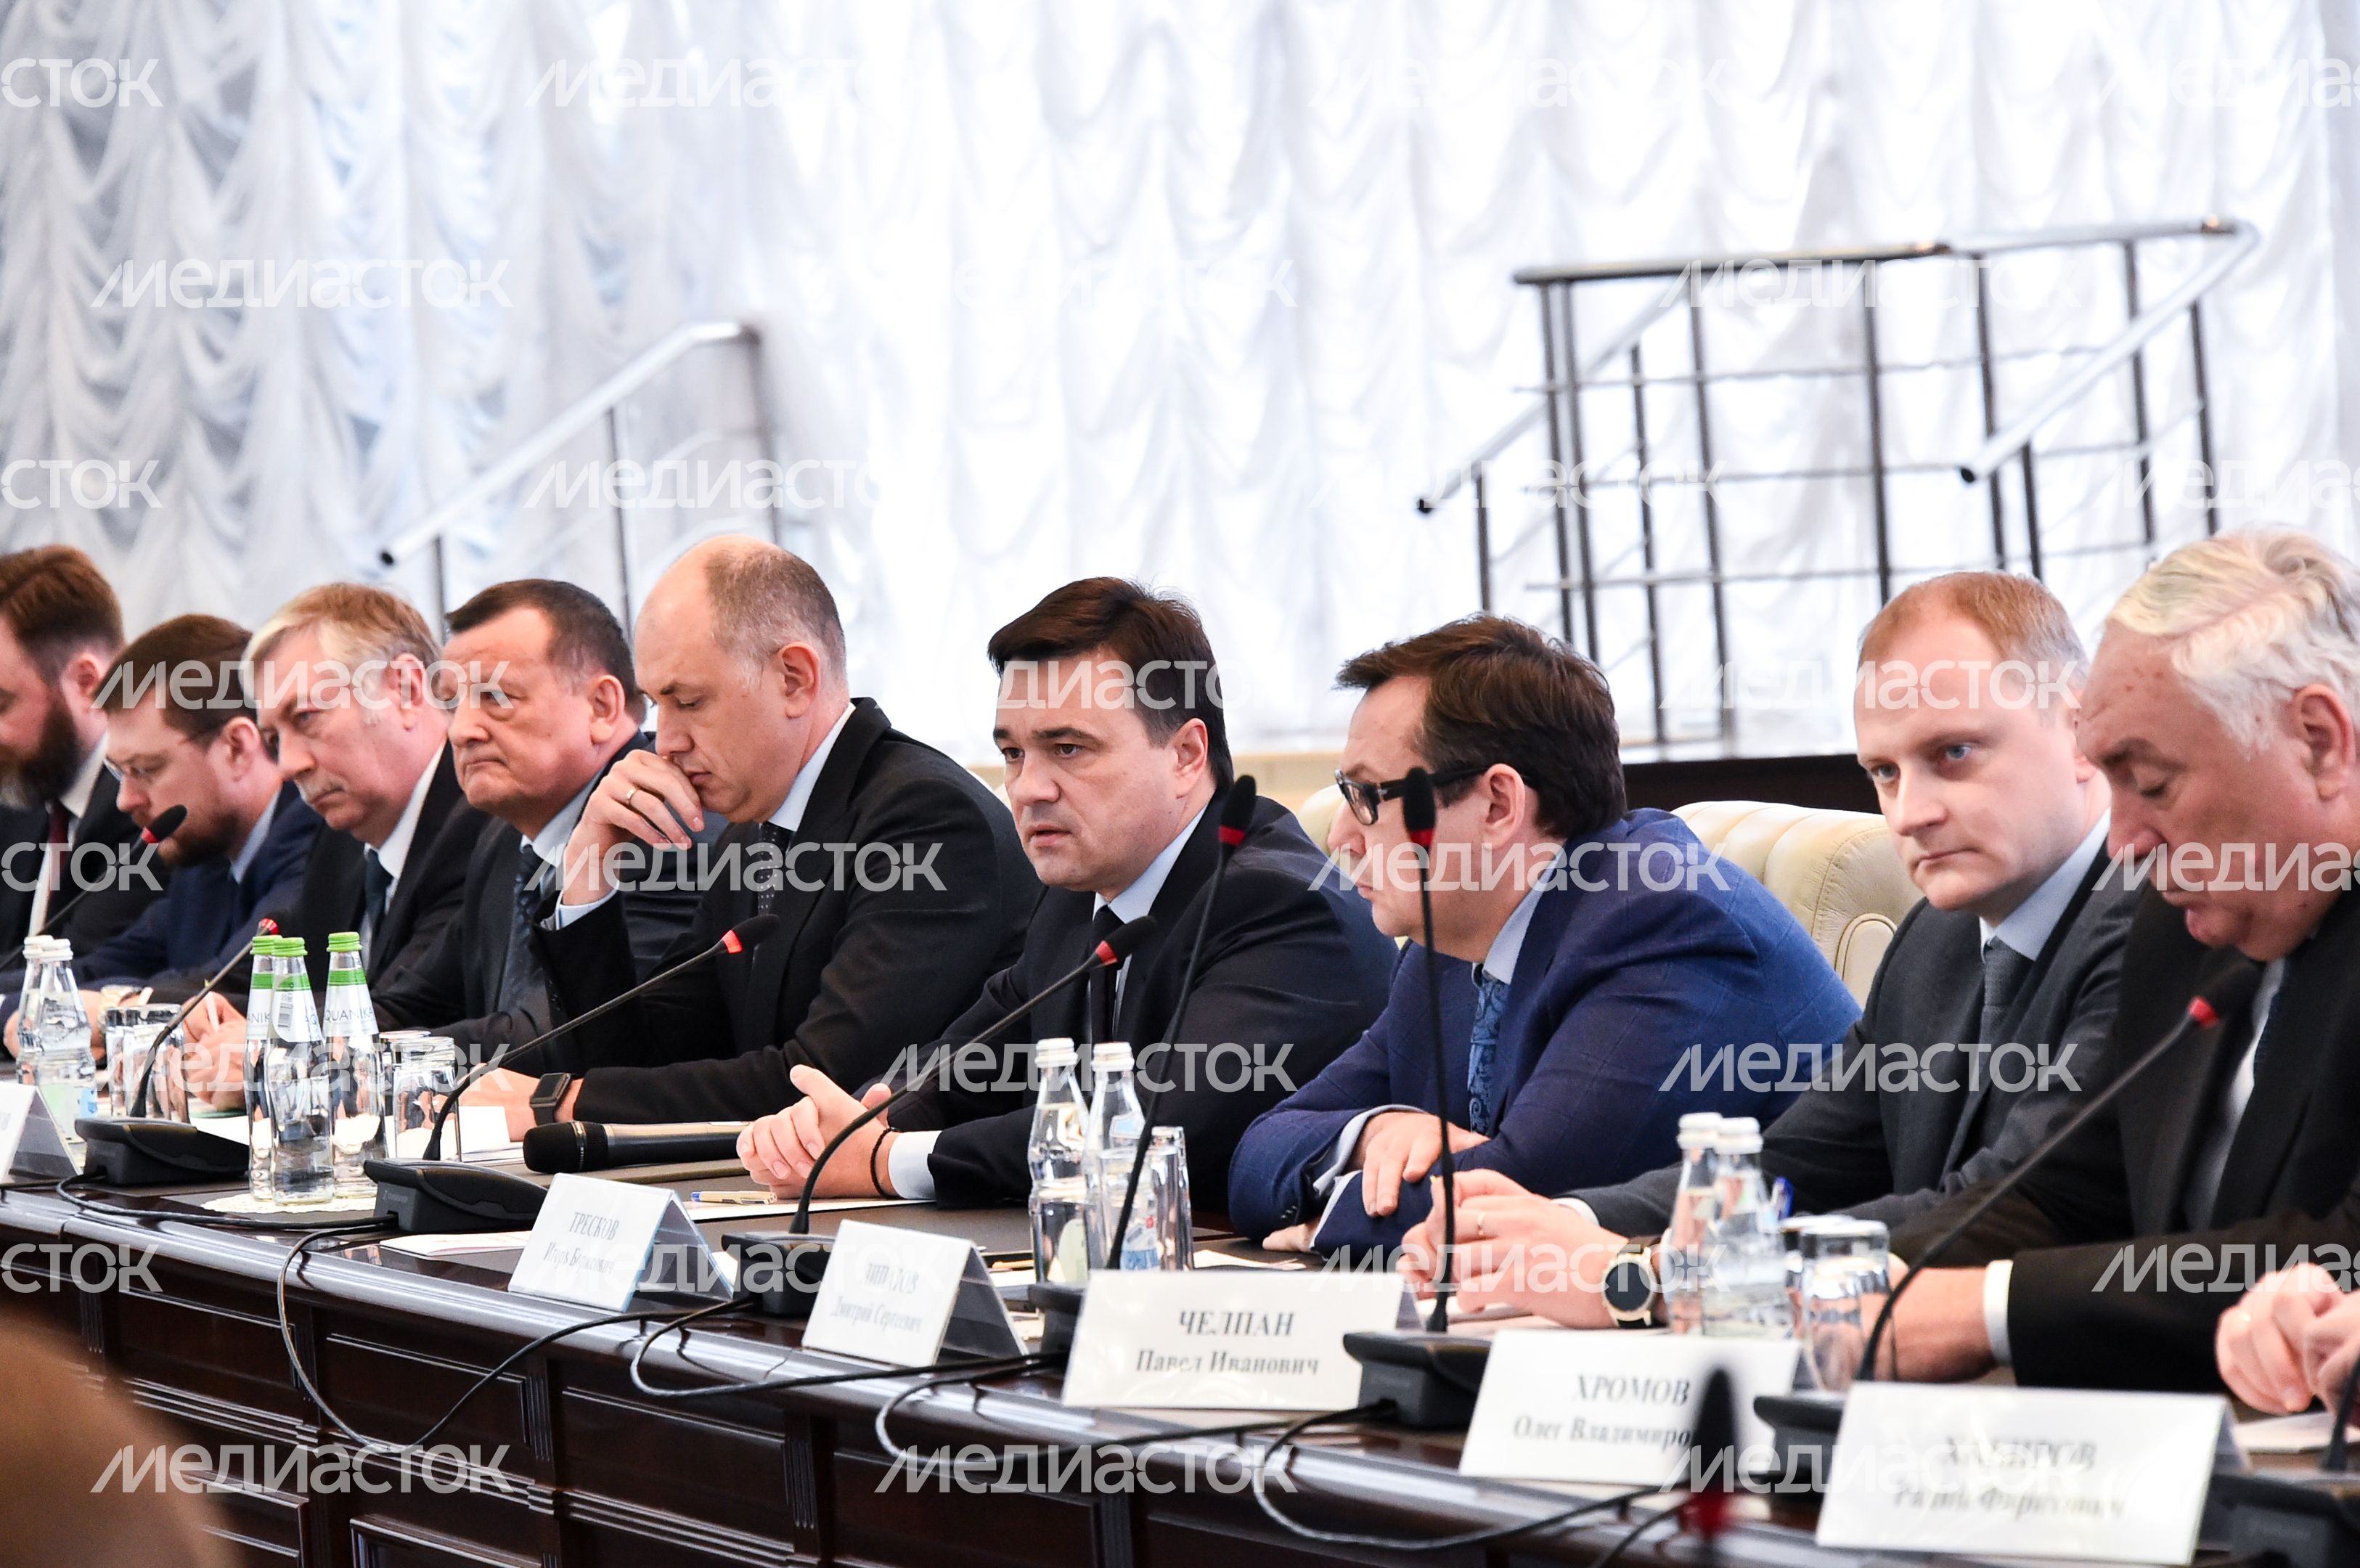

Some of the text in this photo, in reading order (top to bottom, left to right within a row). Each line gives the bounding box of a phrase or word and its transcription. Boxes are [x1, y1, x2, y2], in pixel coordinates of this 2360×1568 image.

[569, 1212, 619, 1240] ТРЕСКОВ
[1179, 1310, 1294, 1336] ЧЕЛПАН
[1135, 1348, 1319, 1376] Павел Иванович
[1571, 1375, 1691, 1406] ХРОМОВ
[1570, 1416, 1693, 1453] Владимиро
